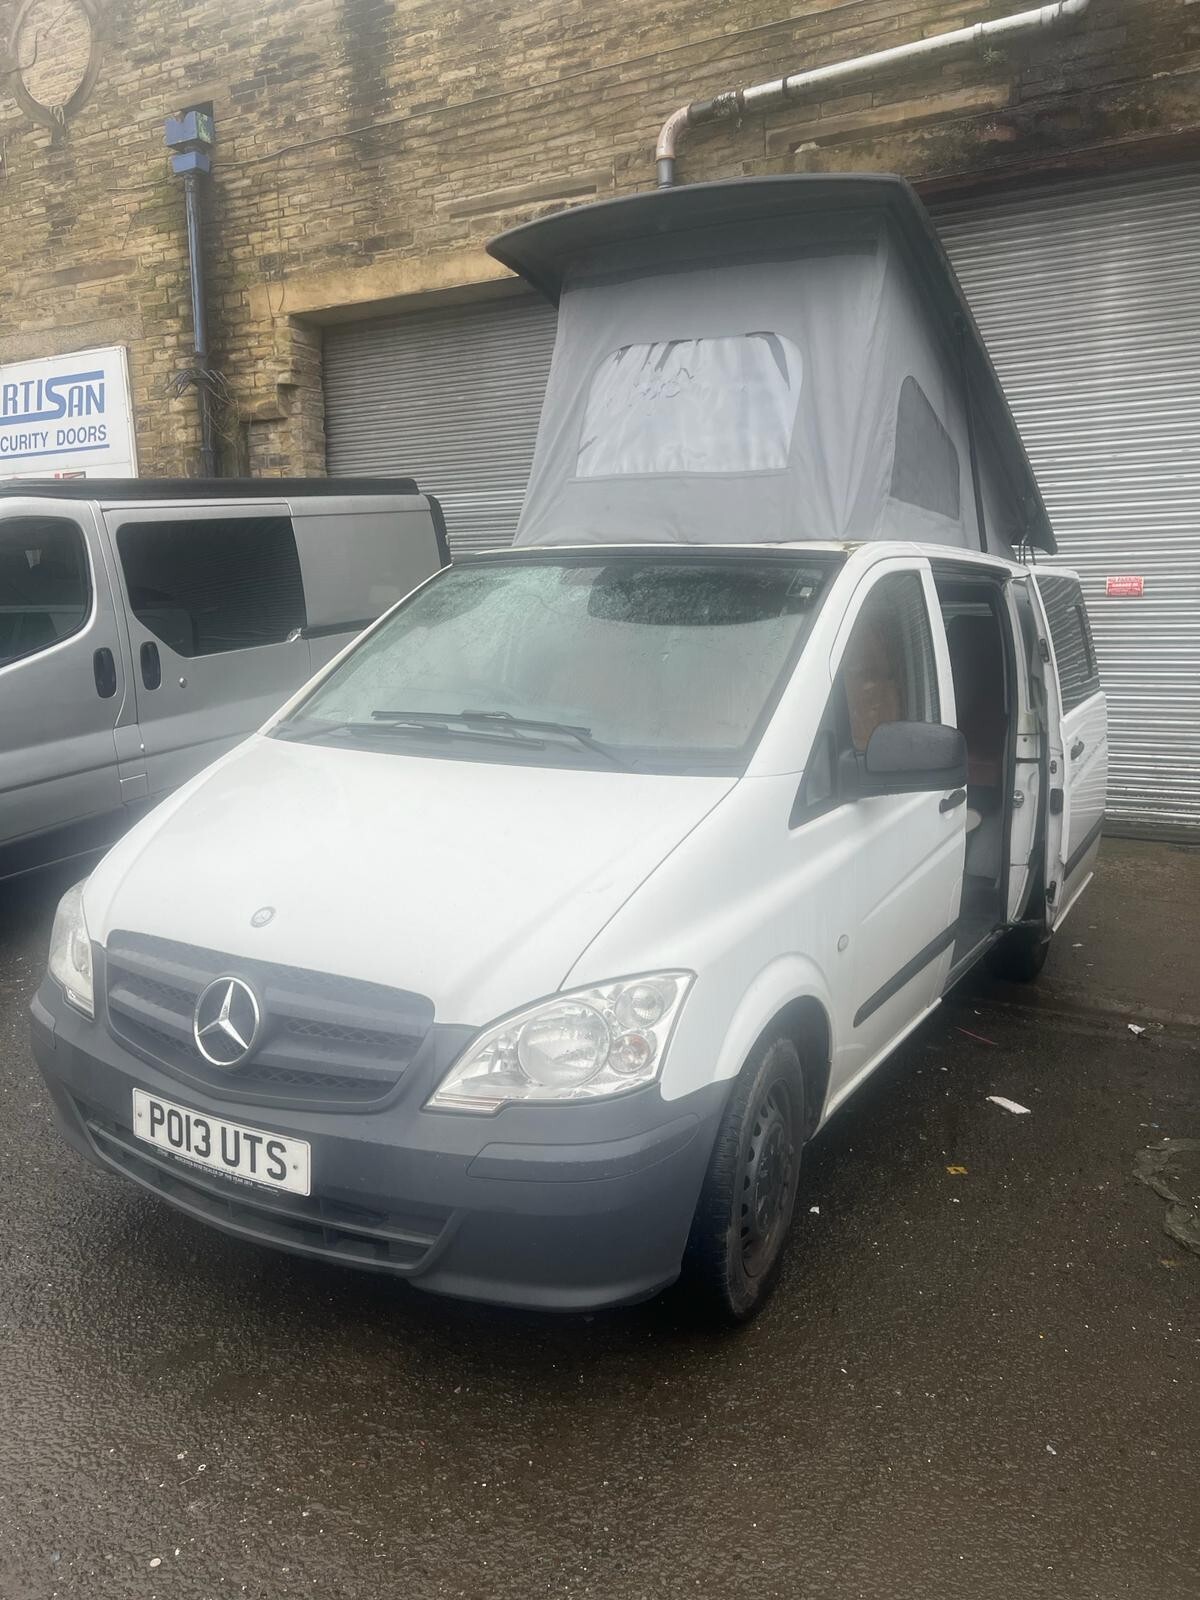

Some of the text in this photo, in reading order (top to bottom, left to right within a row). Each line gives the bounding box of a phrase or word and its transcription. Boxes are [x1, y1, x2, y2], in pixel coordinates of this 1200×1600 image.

[0, 370, 105, 426] RTISAN
[0, 424, 107, 452] CURITY DOORS
[149, 1100, 287, 1181] PO13 UTS
